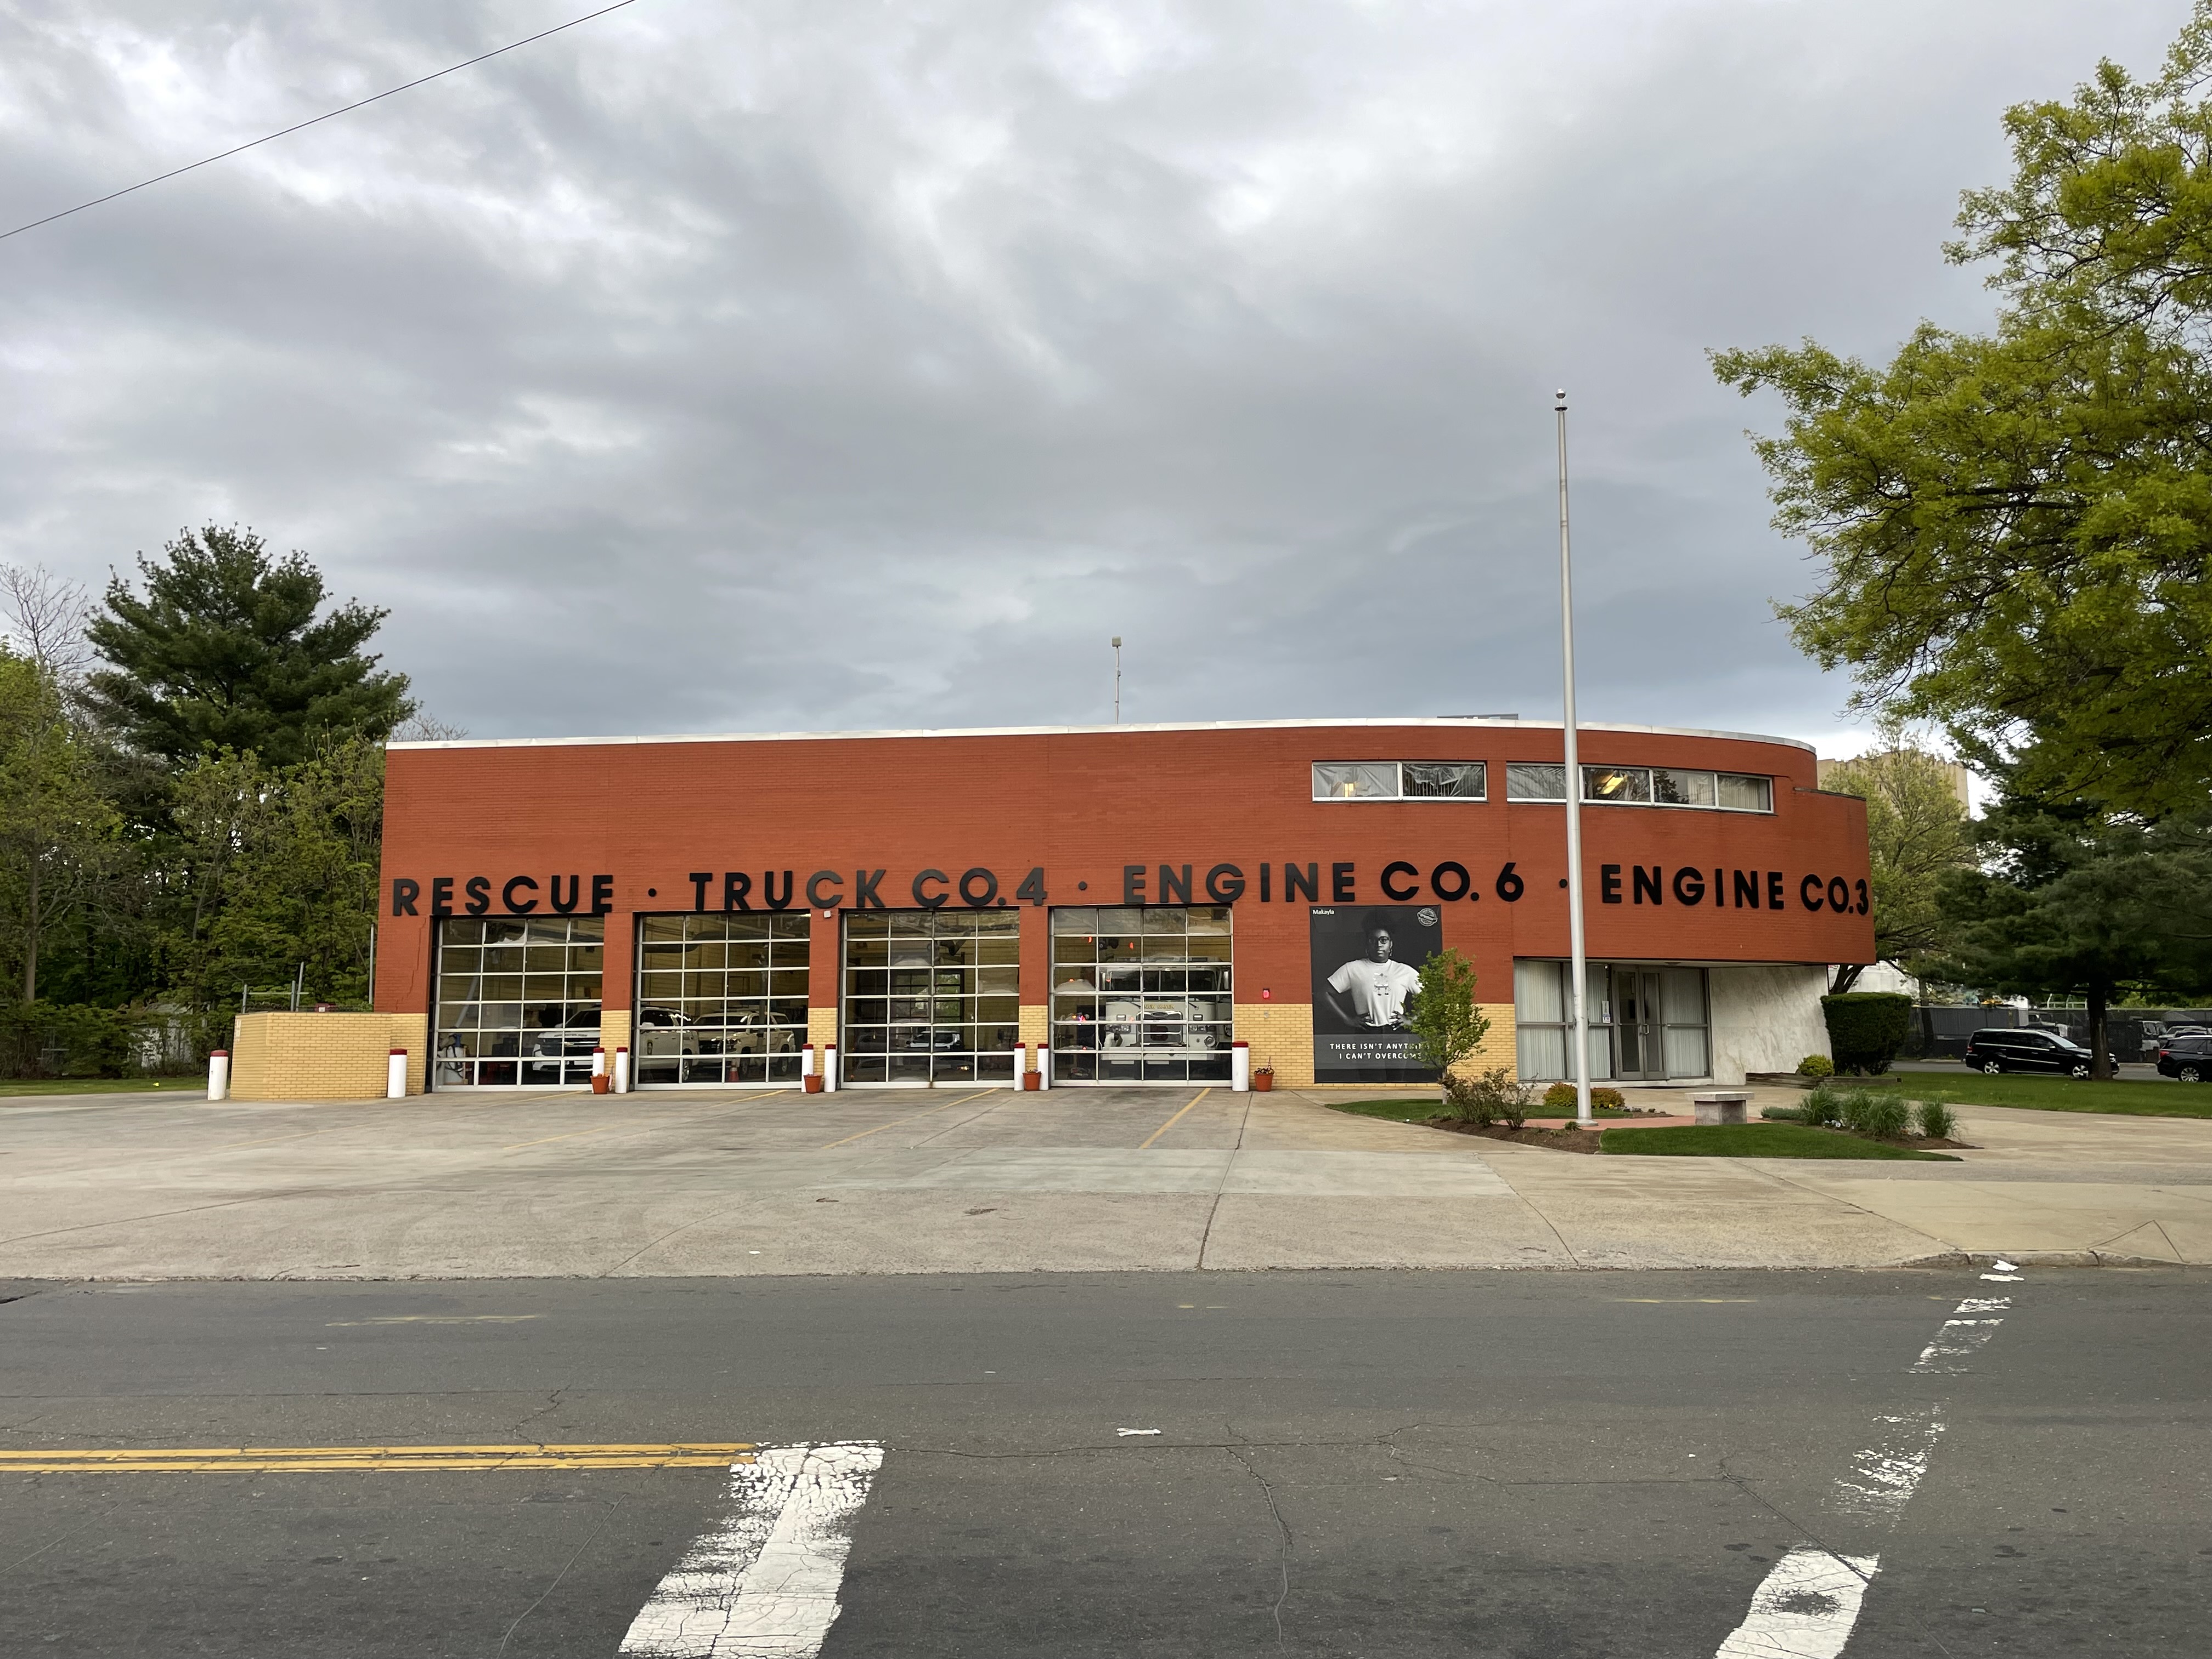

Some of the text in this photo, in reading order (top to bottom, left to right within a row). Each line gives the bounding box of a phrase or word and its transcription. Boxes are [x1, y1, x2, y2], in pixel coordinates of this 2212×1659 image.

[393, 875, 614, 916] RESCUE
[689, 869, 887, 911] TRUCK
[1123, 862, 1356, 904] ENGINE
[1601, 864, 1785, 910] ENGINE
